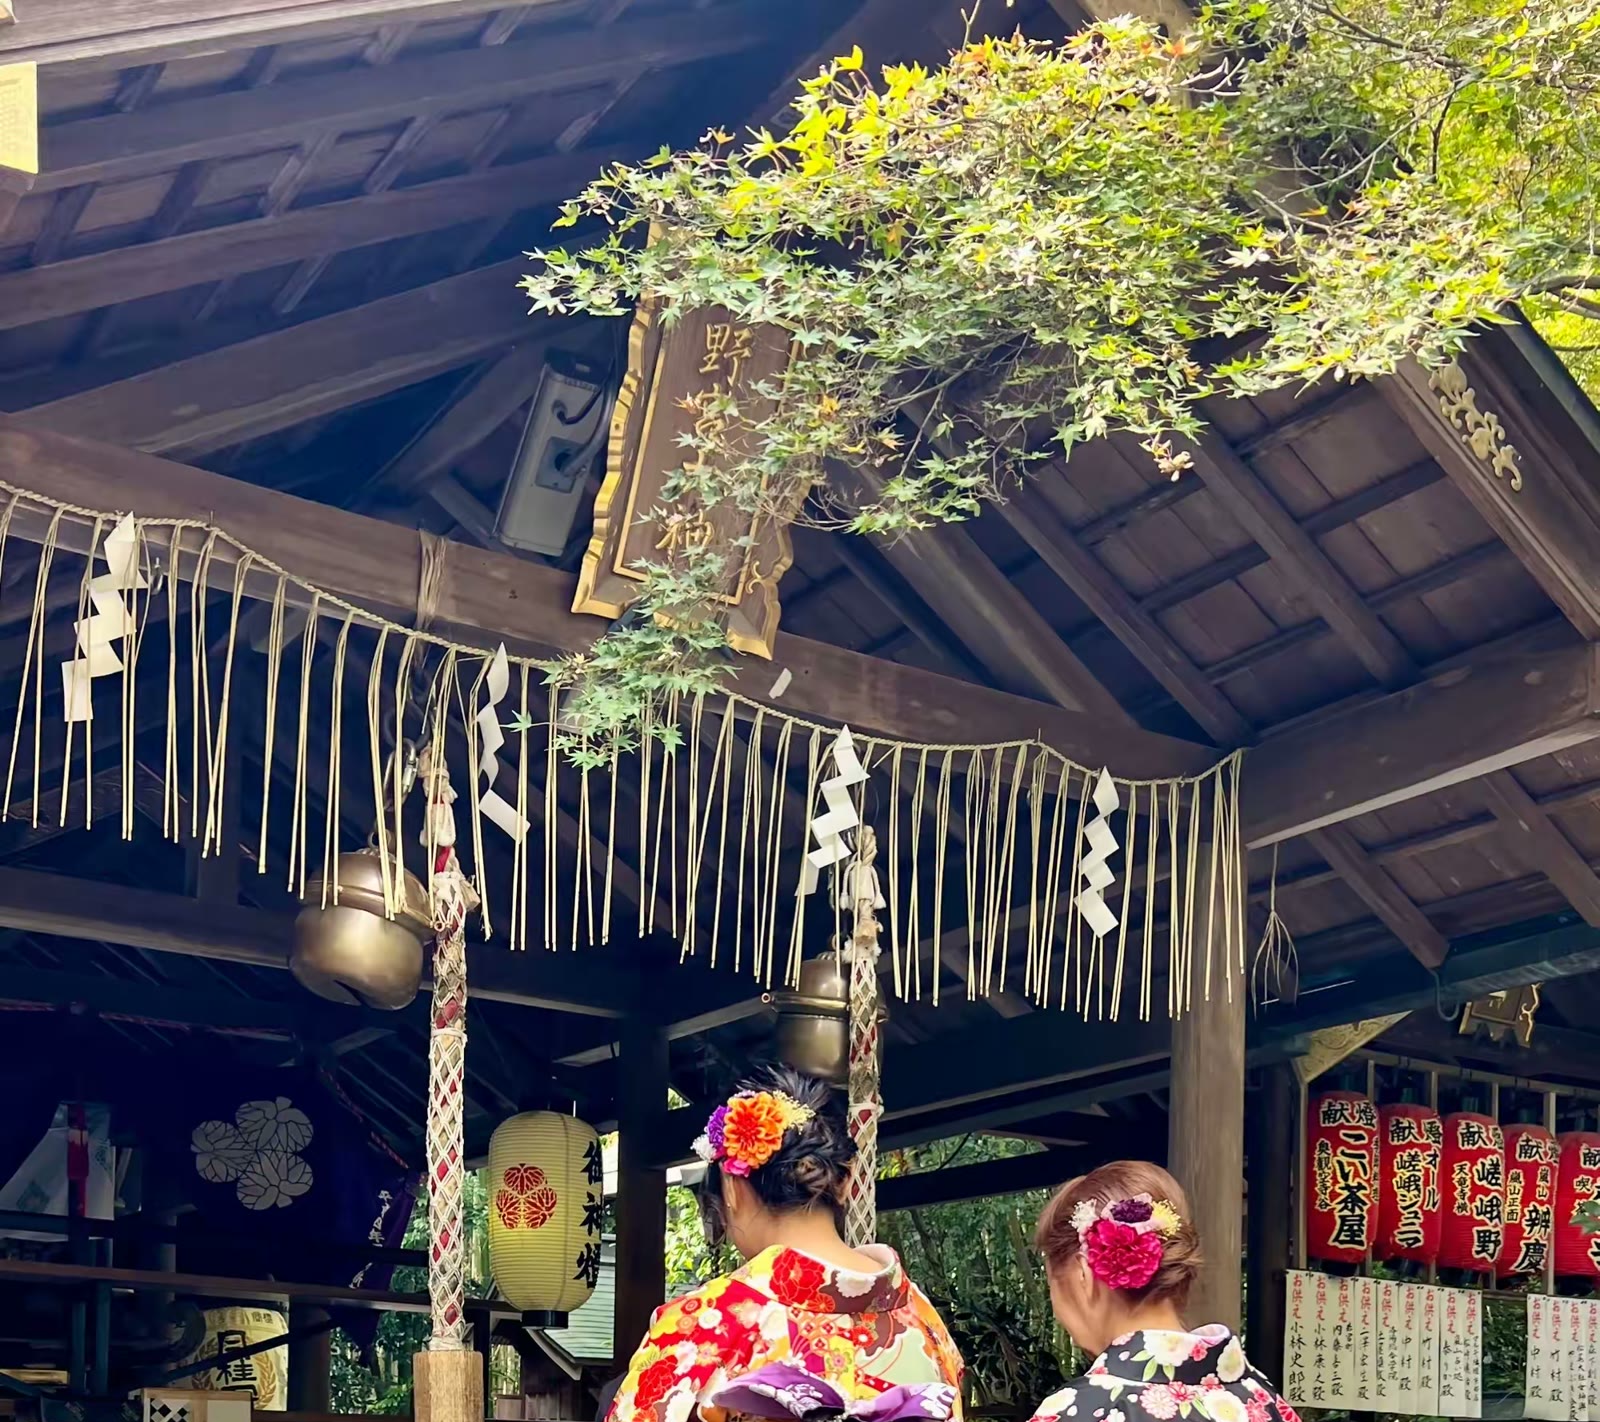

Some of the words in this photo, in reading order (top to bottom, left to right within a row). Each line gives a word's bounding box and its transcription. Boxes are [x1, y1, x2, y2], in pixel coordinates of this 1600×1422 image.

[1330, 1130, 1369, 1249] こい茶屋
[1424, 1149, 1440, 1212] オール
[1474, 1155, 1503, 1262] 嵯峨野
